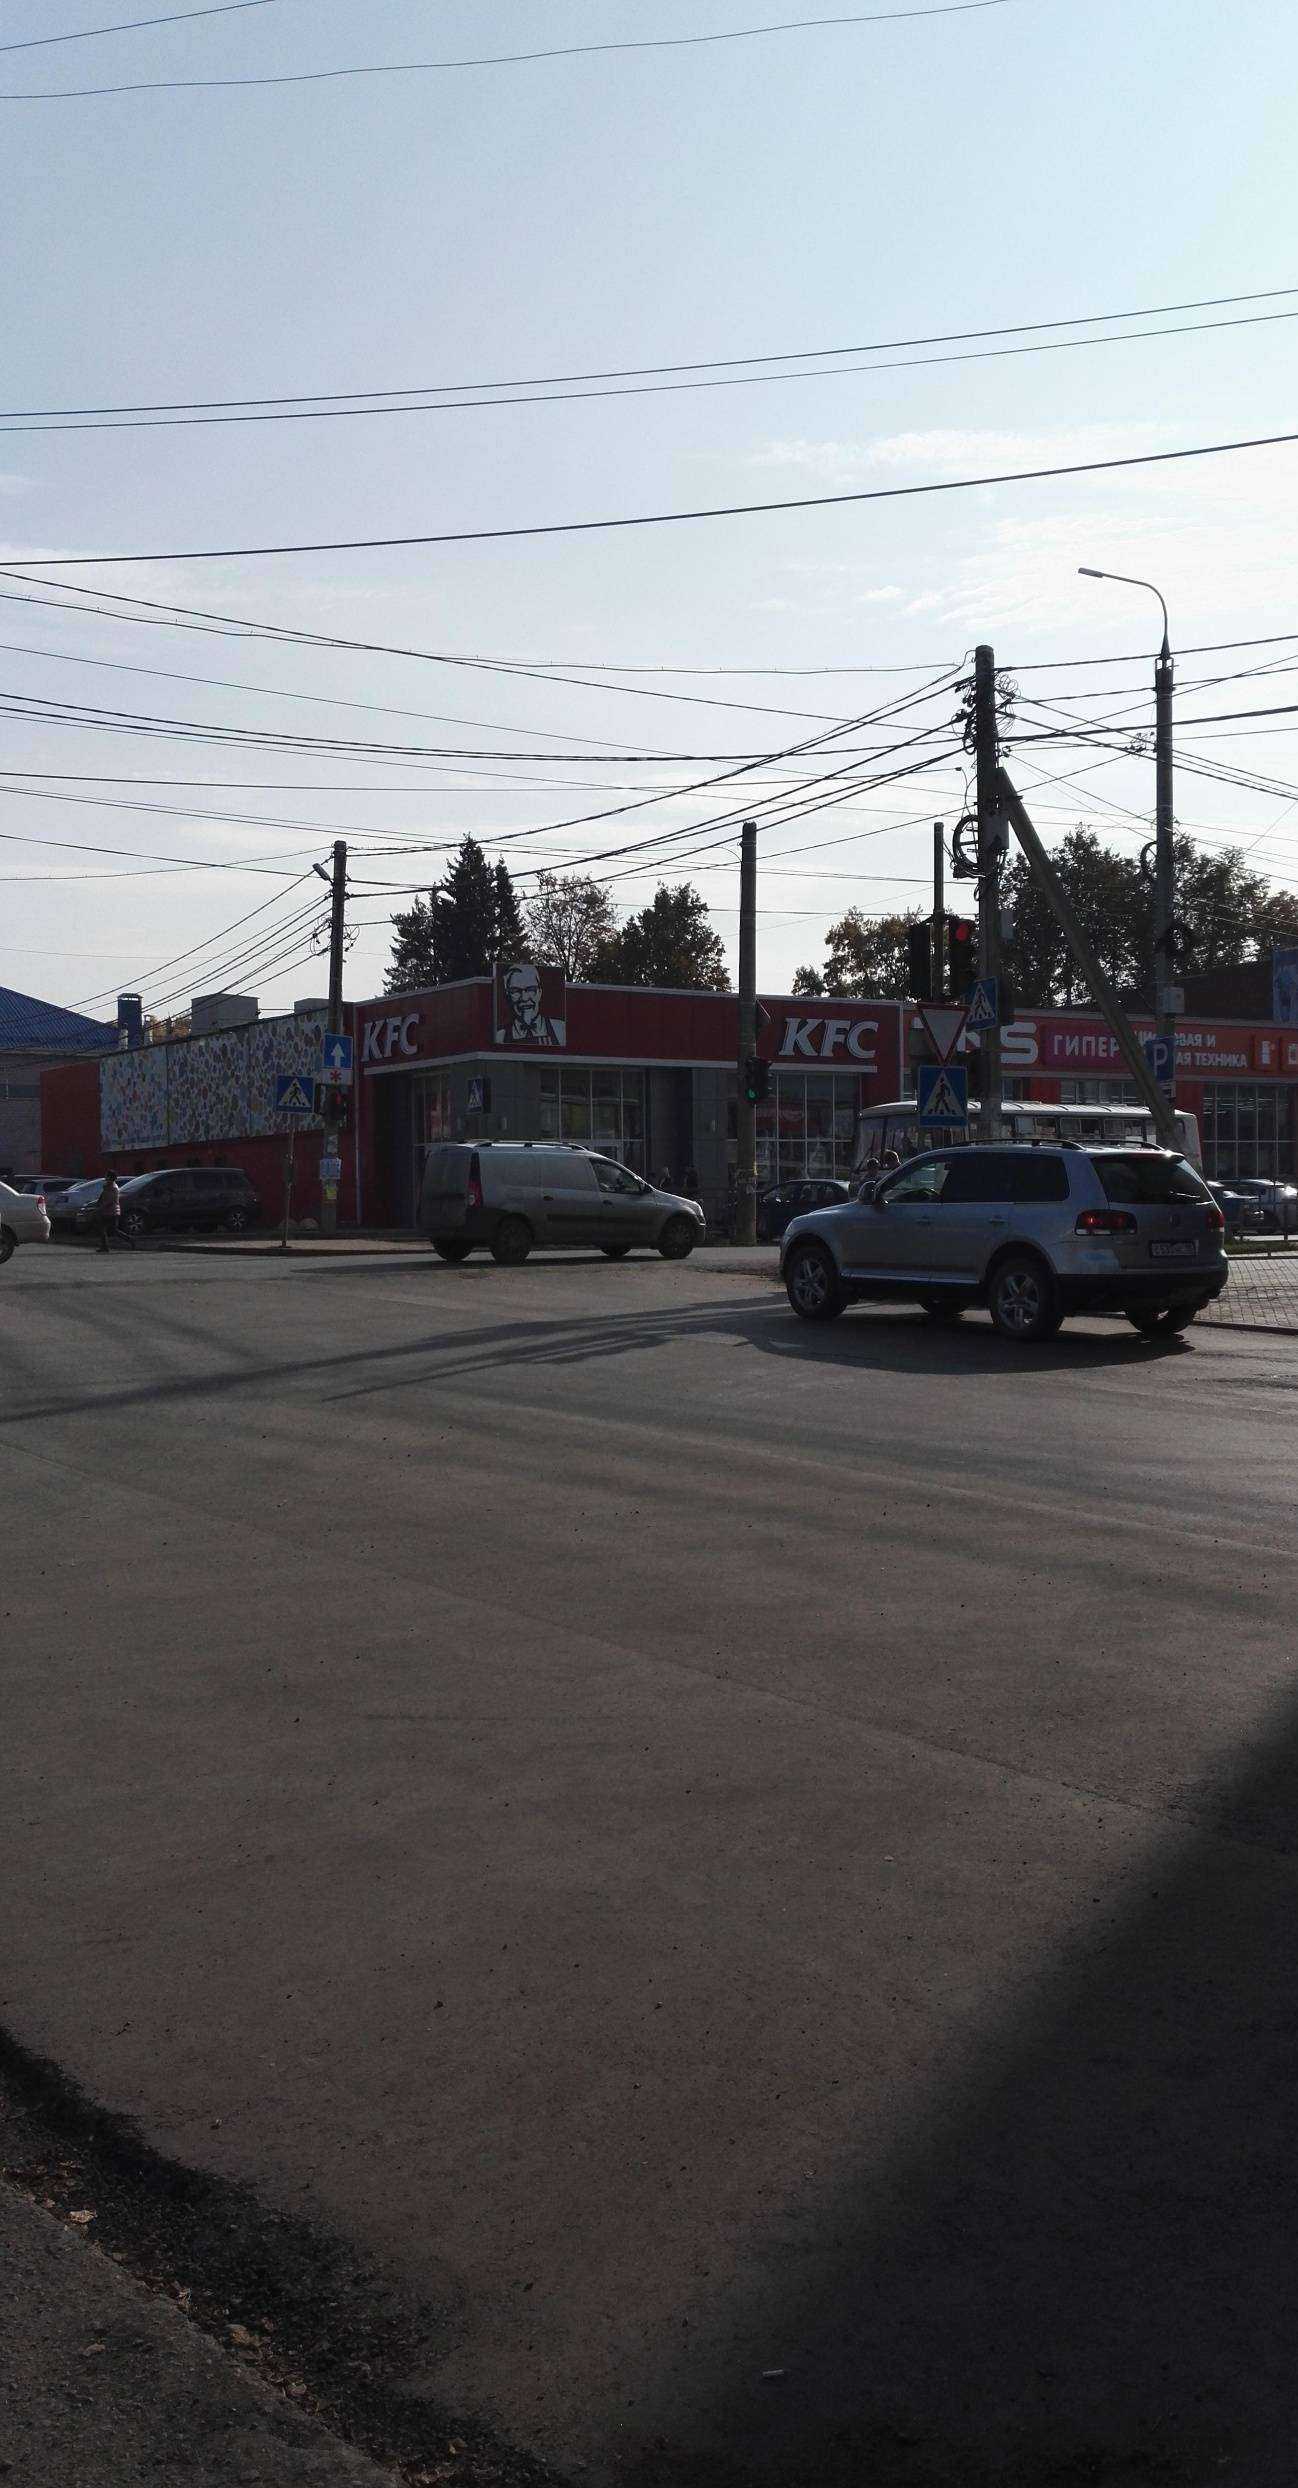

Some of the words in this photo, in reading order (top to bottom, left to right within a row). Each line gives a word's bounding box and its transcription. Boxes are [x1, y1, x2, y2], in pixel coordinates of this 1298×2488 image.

[361, 1012, 420, 1062] KFC
[778, 1017, 879, 1059] KFC
[1054, 1034, 1121, 1057] ГИПЕР
[1207, 1033, 1216, 1048] И
[1152, 1043, 1169, 1078] P
[1194, 1051, 1248, 1068] ТЕХНИКА
